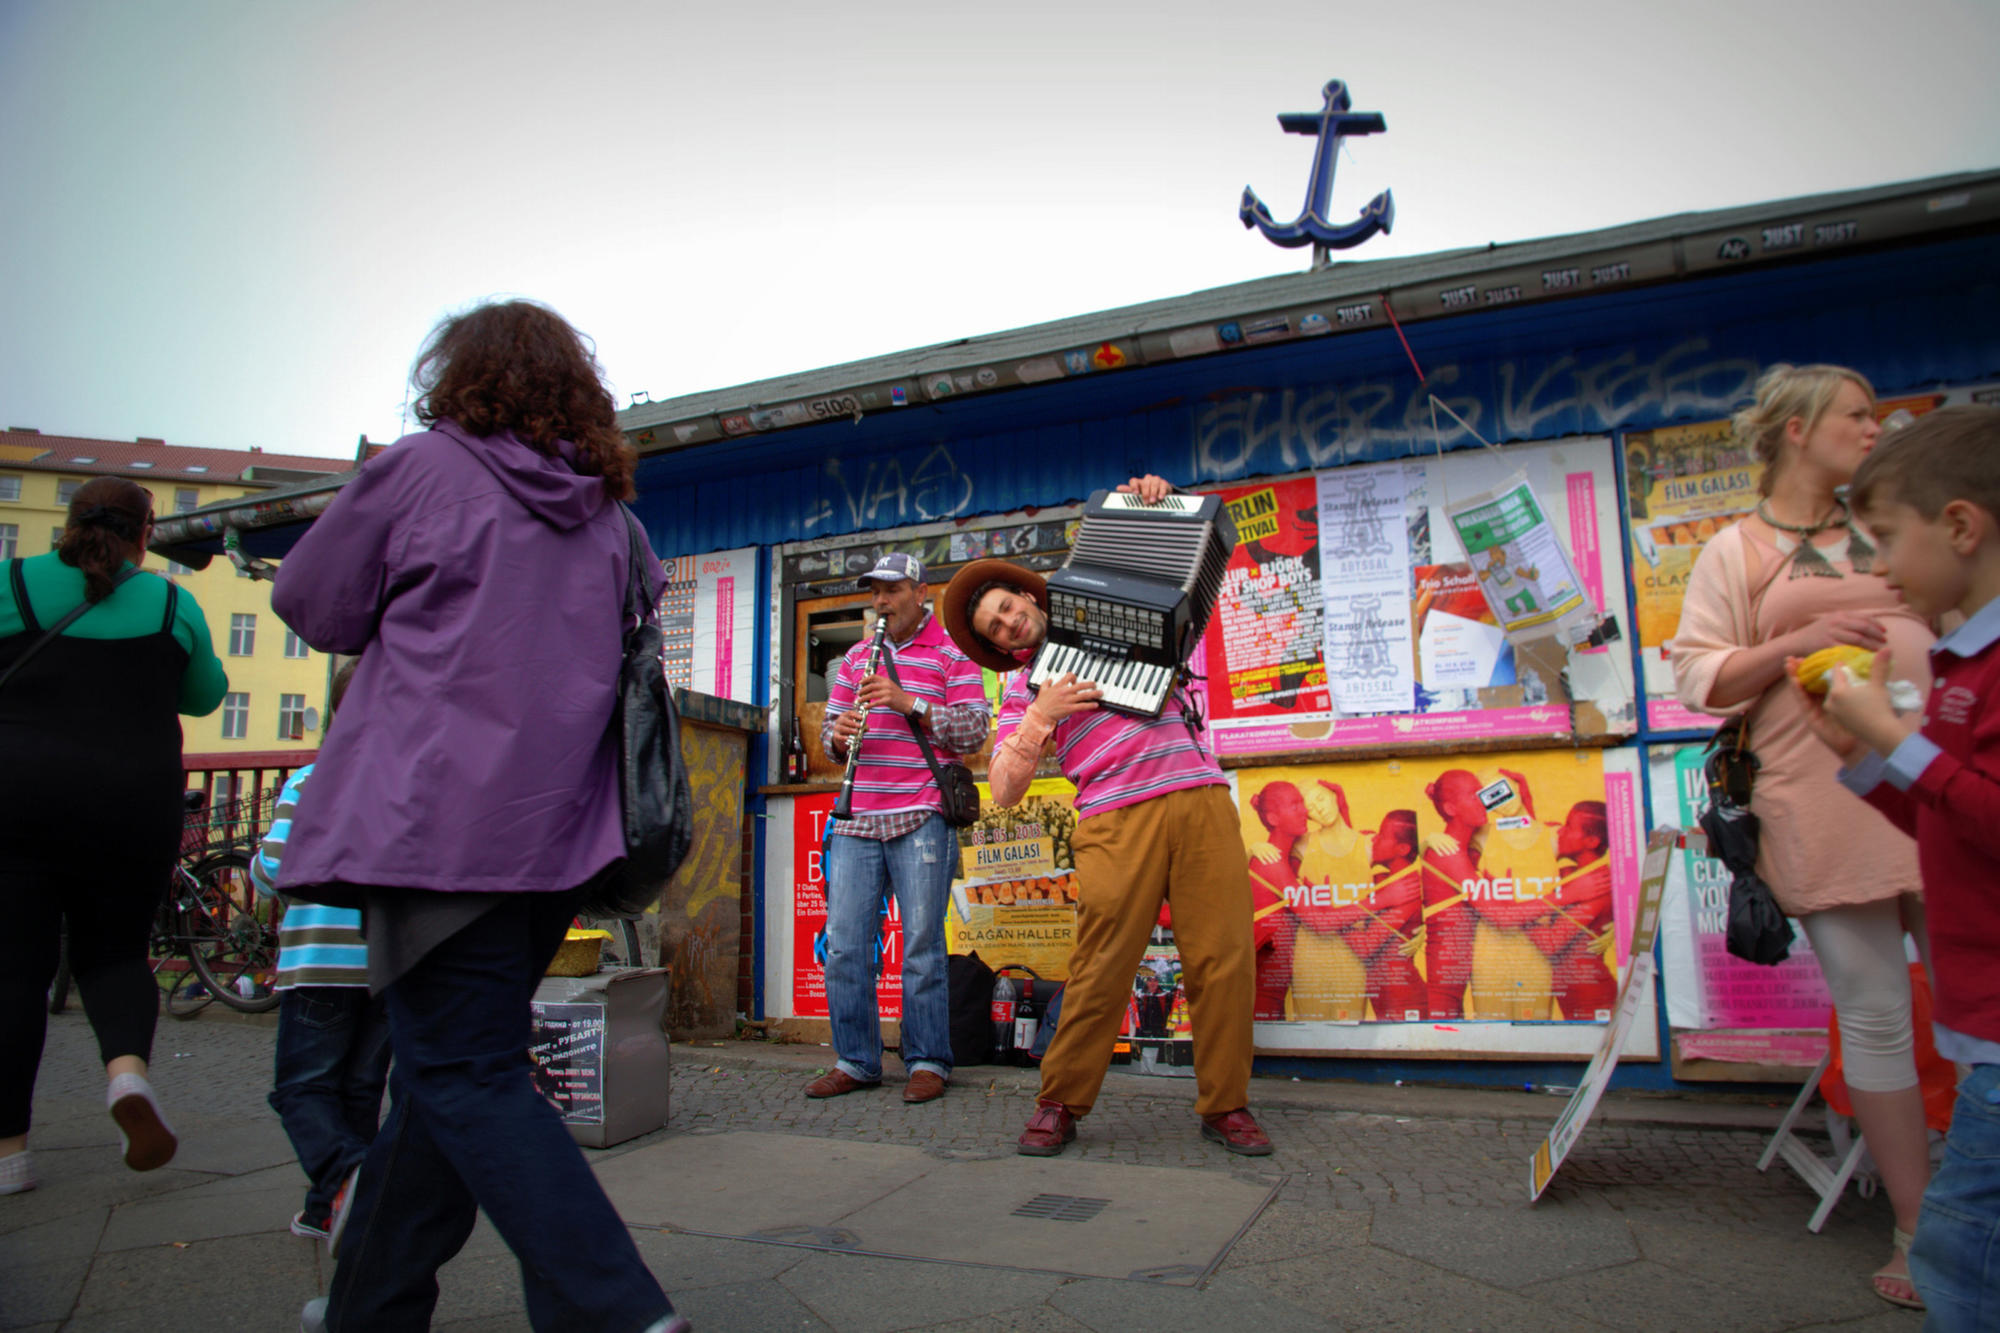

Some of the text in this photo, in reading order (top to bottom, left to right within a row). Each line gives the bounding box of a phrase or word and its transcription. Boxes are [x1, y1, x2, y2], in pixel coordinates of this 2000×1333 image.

[1763, 224, 1803, 248] JUST
[1815, 222, 1856, 243] JUST
[1543, 269, 1580, 288] JUST
[1592, 263, 1630, 284] JUST
[1441, 287, 1476, 307] JUST
[1486, 287, 1520, 304] JUST
[1336, 304, 1371, 324] JUST
[1228, 491, 1275, 522] RLIN
[1261, 555, 1304, 578] BJÖRK
[1242, 576, 1276, 594] SHOP
[1278, 567, 1313, 587] BOYS
[1015, 823, 1042, 841] 2013
[1004, 843, 1040, 861] GALASI
[1284, 882, 1376, 907] MELT!
[1462, 876, 1562, 902] MELT!
[1017, 928, 1071, 941] HALLER
